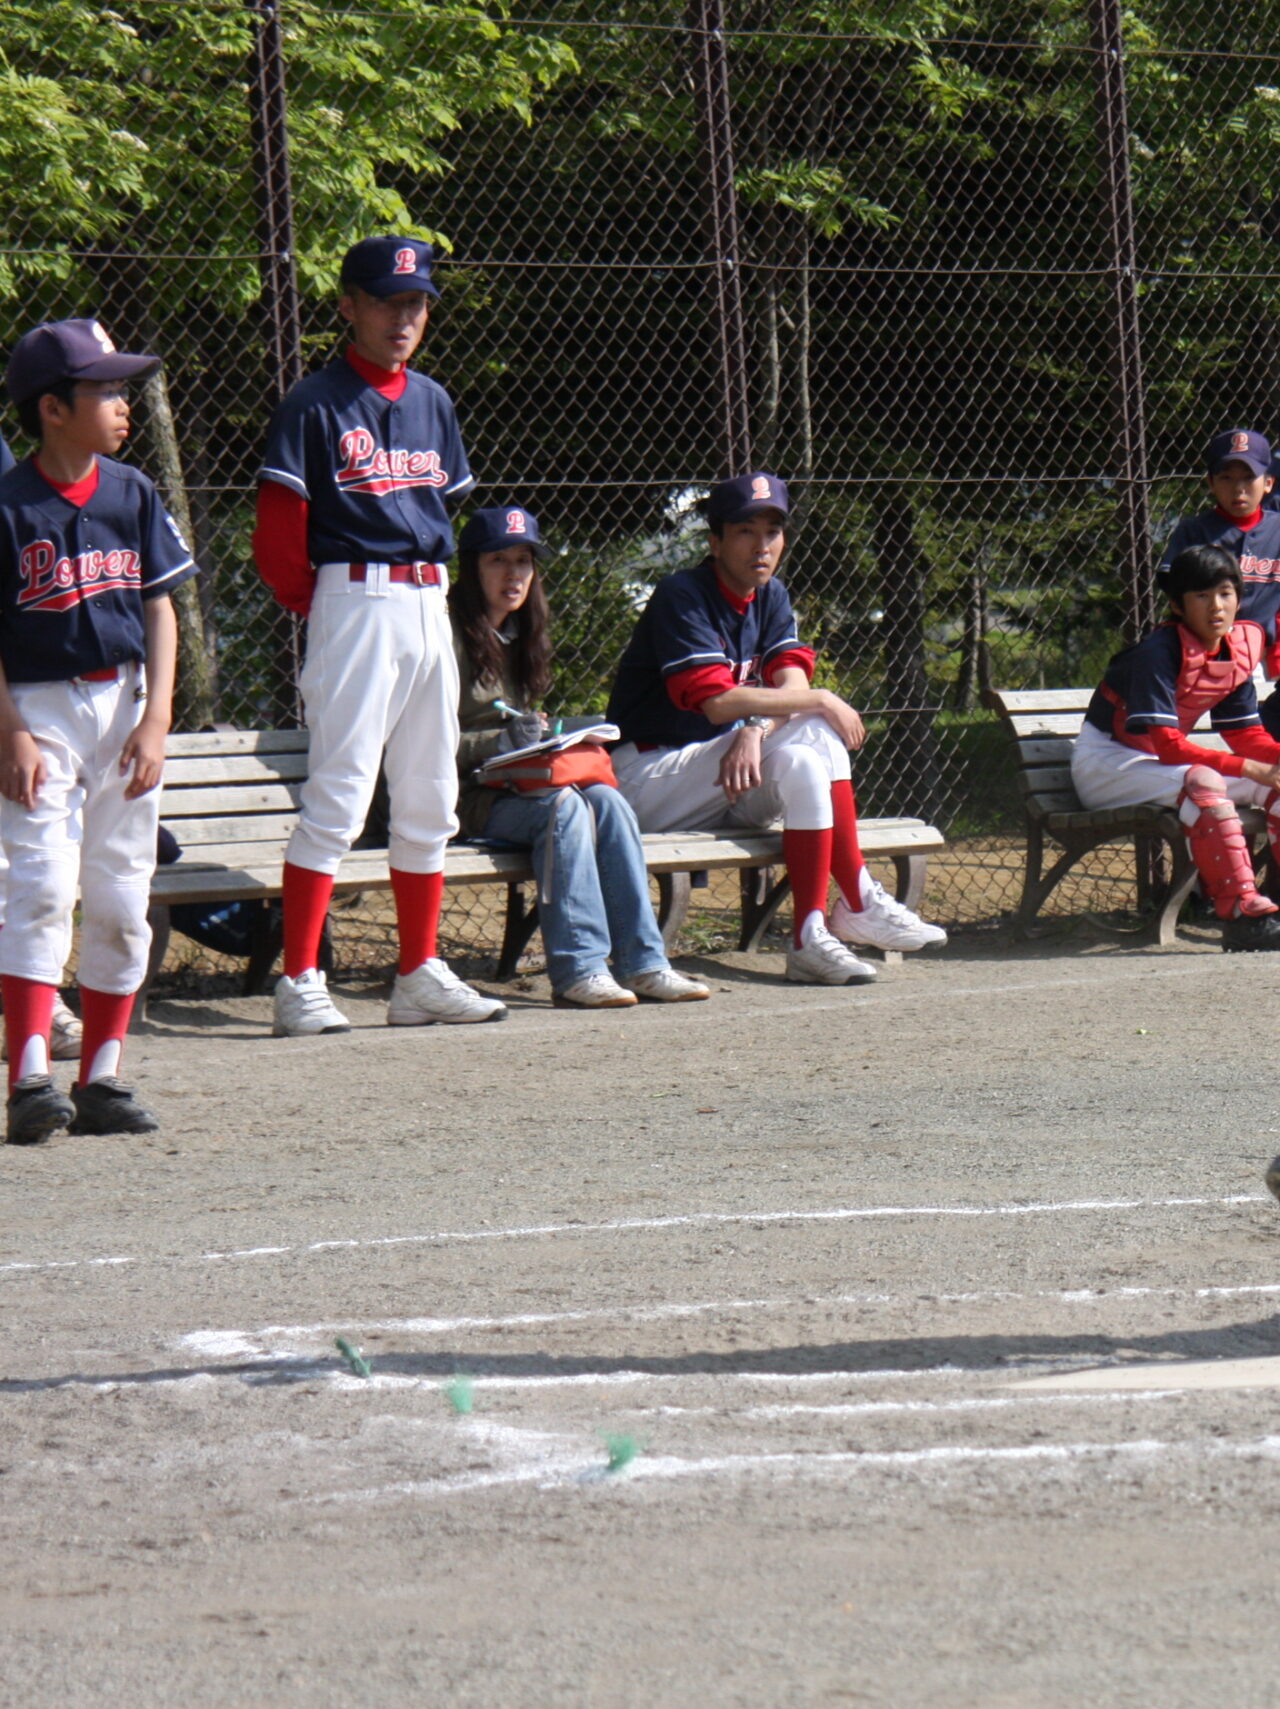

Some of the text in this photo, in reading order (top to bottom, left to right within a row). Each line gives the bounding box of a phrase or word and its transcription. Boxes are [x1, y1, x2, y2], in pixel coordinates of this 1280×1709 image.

[392, 247, 416, 274] P
[335, 426, 448, 484] Power
[1230, 432, 1249, 452] P
[505, 510, 526, 534] P
[16, 539, 141, 605] Power
